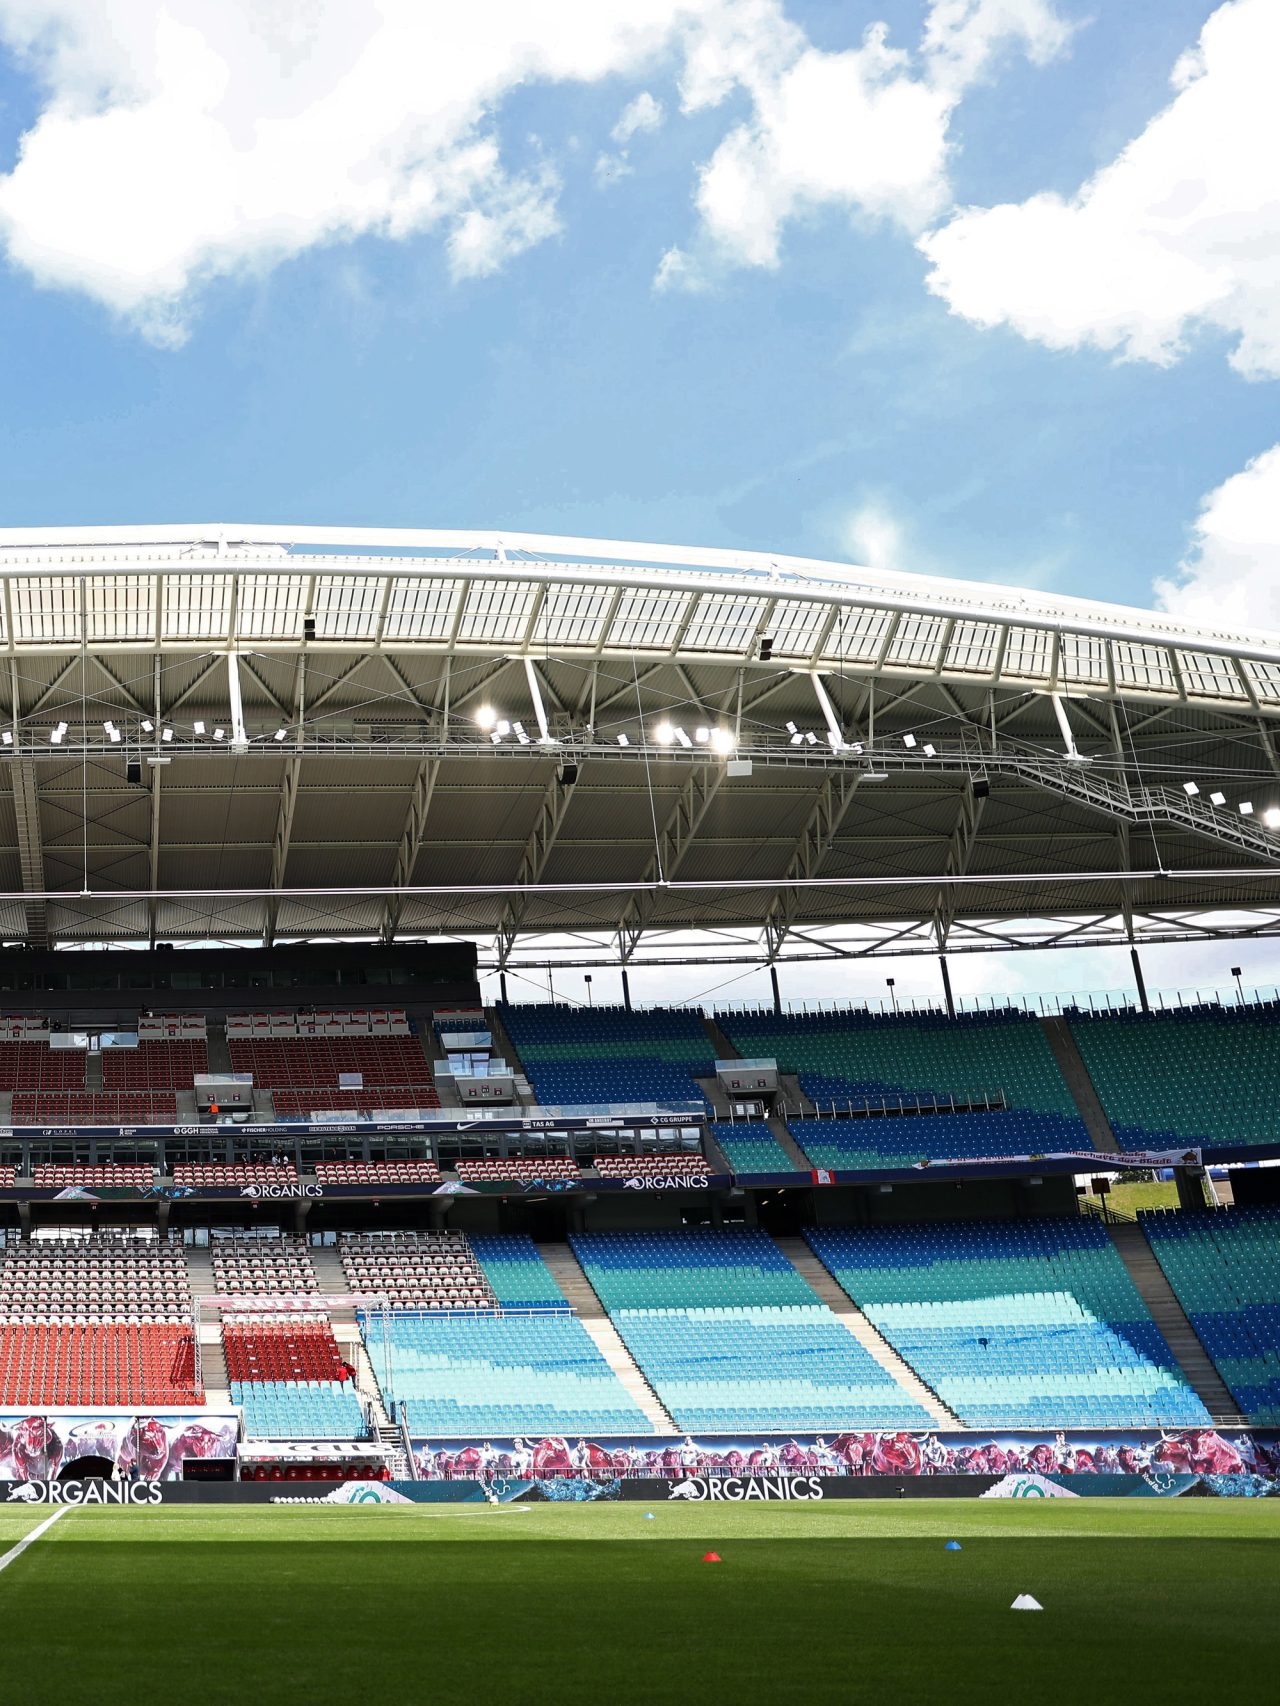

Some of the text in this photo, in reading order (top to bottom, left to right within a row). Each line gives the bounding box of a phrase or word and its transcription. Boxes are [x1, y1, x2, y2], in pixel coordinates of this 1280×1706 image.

[251, 1184, 323, 1198] ORGANICS
[634, 1175, 709, 1190] ORGANICS
[25, 1480, 163, 1505] ORGANICS
[687, 1477, 824, 1501] ORGANICS
